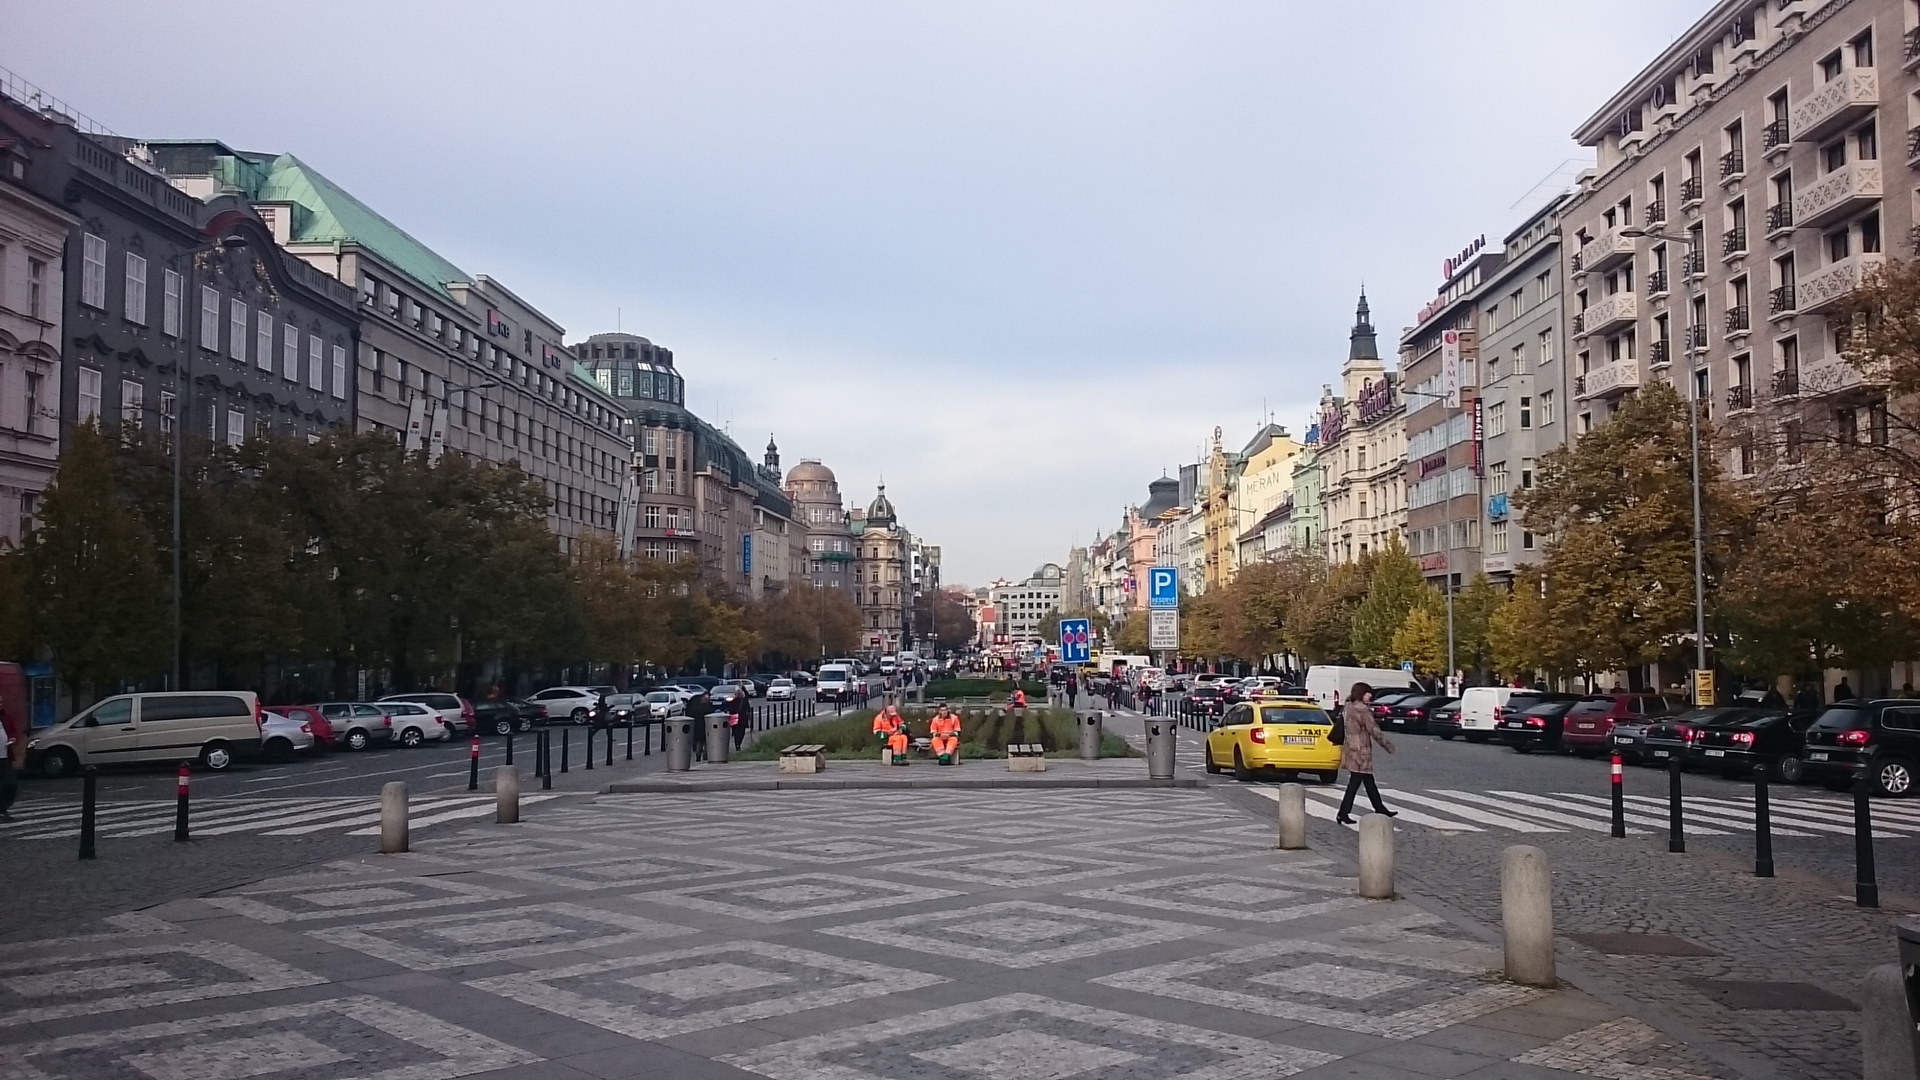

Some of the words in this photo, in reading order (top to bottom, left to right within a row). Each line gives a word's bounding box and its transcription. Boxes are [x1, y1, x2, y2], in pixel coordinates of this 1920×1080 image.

[1452, 234, 1486, 270] RAMADA
[498, 321, 510, 338] KB
[1447, 349, 1456, 408] RAMADA
[1246, 472, 1280, 495] MERAN
[1155, 571, 1172, 596] P
[1302, 728, 1321, 736] TAXI
